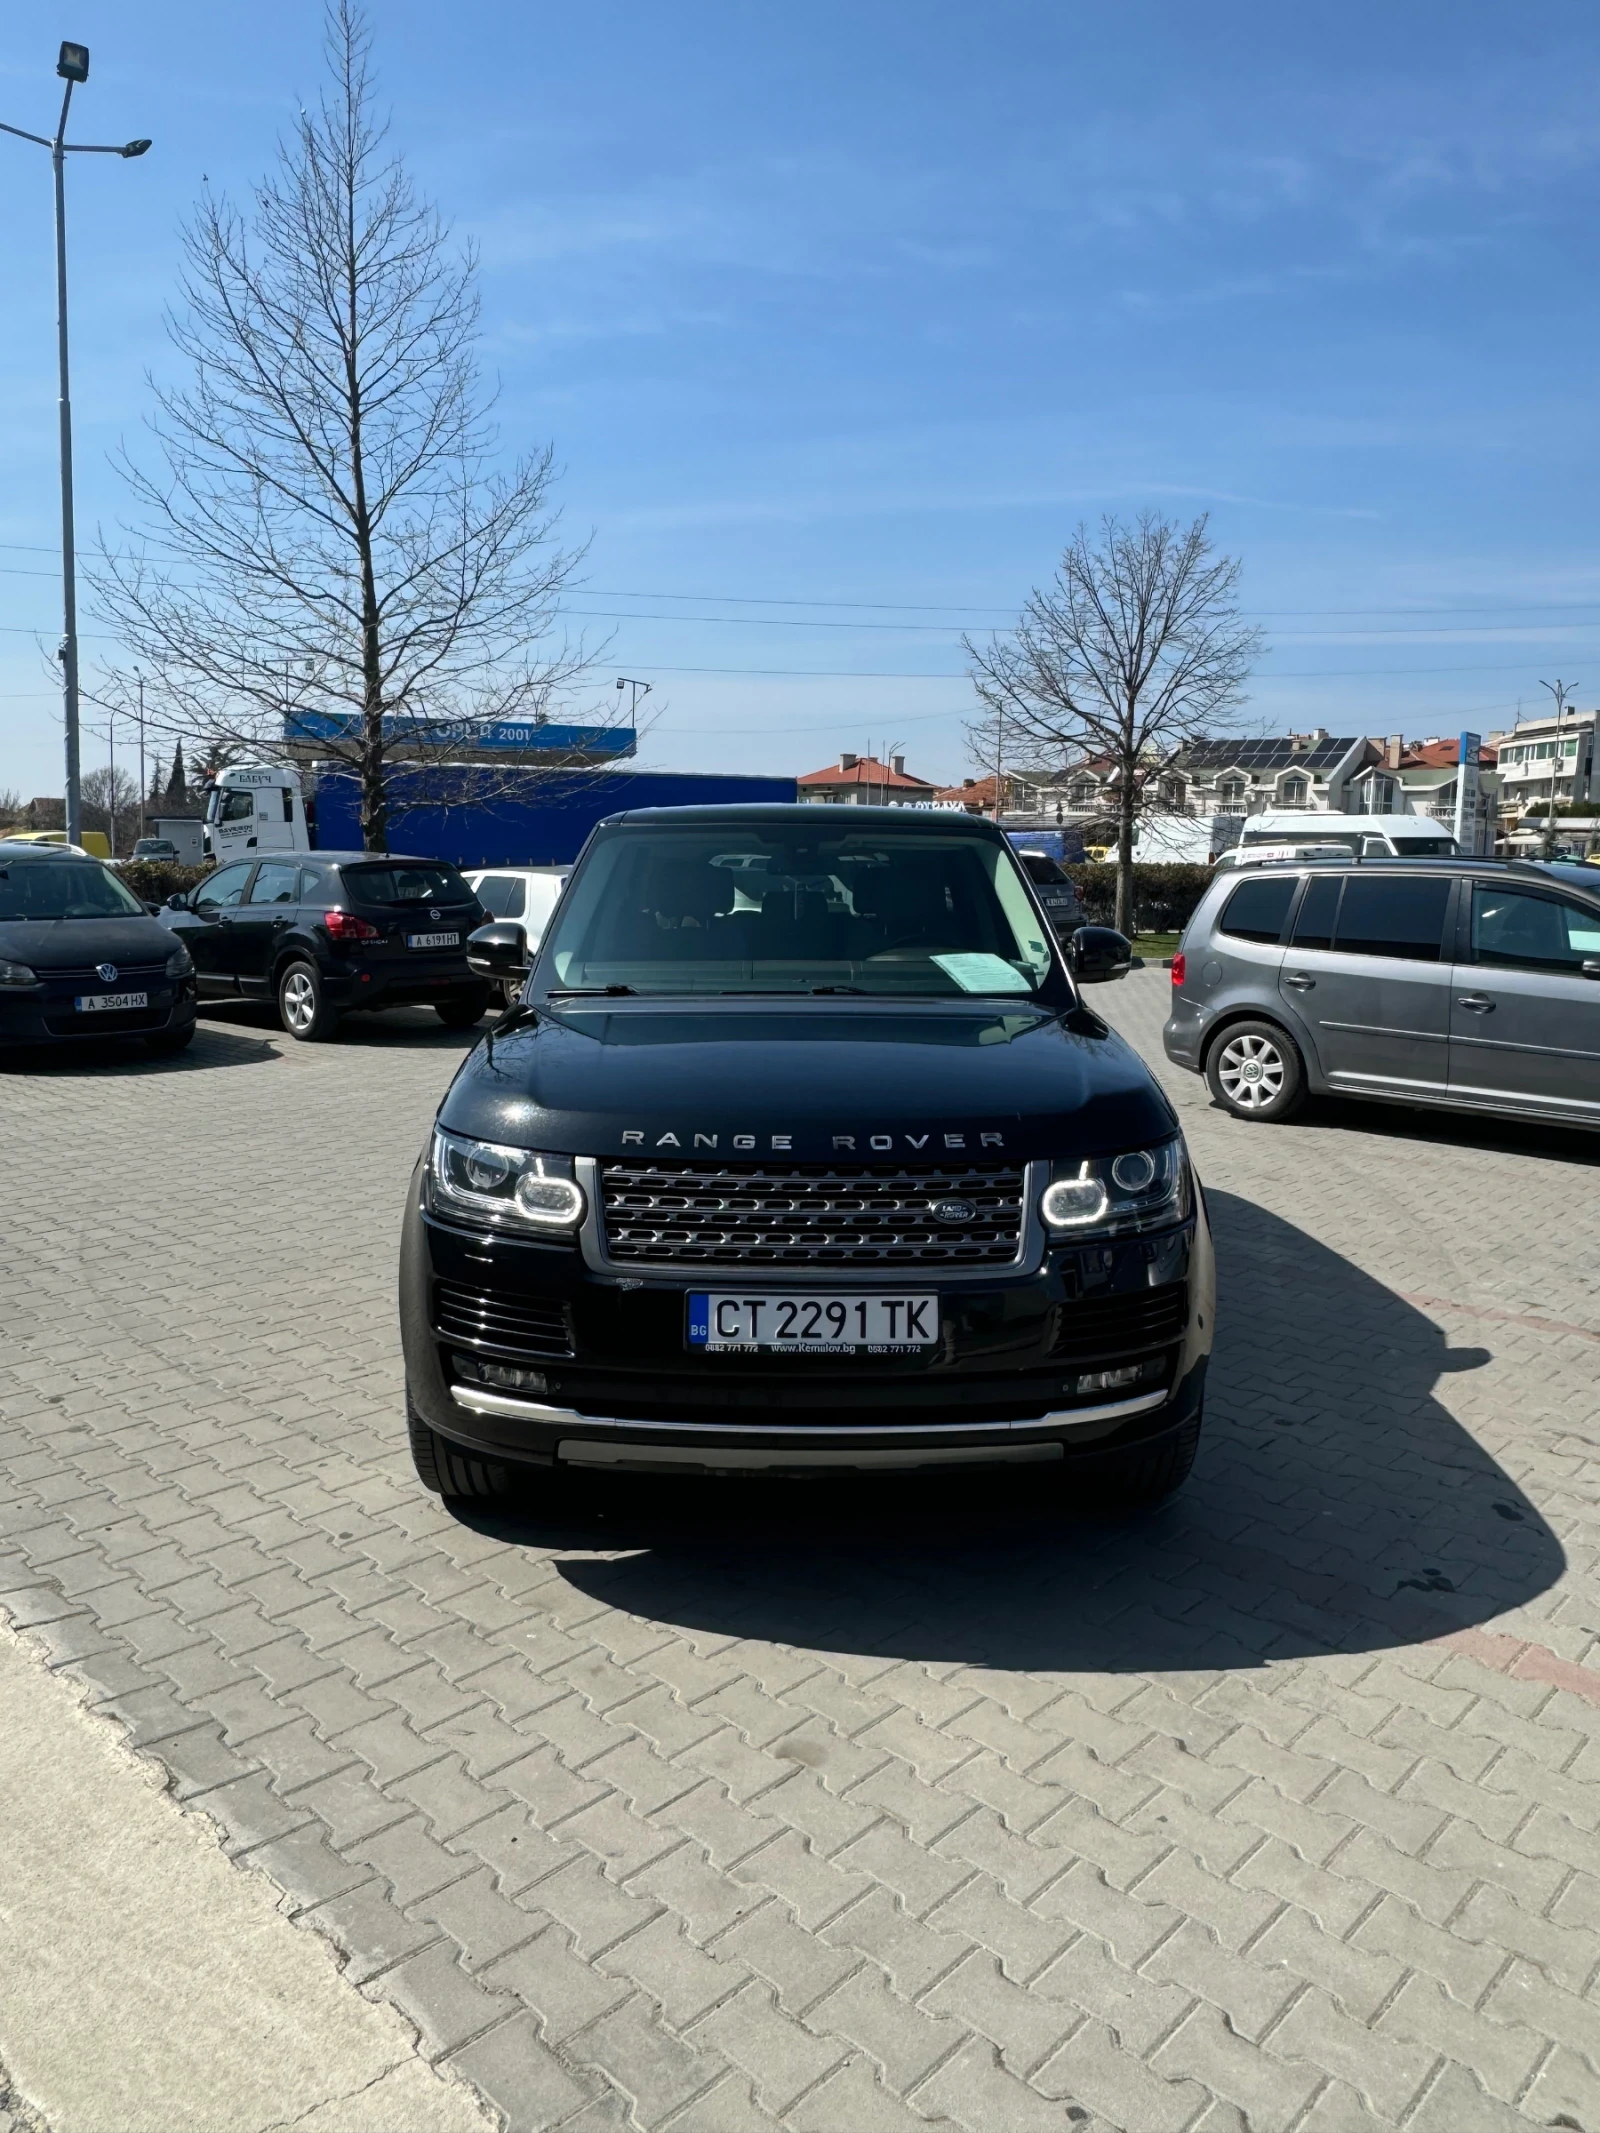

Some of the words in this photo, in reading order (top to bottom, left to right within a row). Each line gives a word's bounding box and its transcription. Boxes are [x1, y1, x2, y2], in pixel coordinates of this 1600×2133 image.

[499, 728, 529, 741] 2001
[88, 998, 95, 1010] A
[101, 996, 129, 1008] 3504
[621, 1130, 793, 1150] RANGE
[832, 1132, 1004, 1150] ROVER
[716, 1300, 766, 1338] CT
[775, 1301, 867, 1339] 2291
[881, 1301, 930, 1339] TK
[691, 1325, 707, 1336] BG
[727, 1344, 741, 1352] 771
